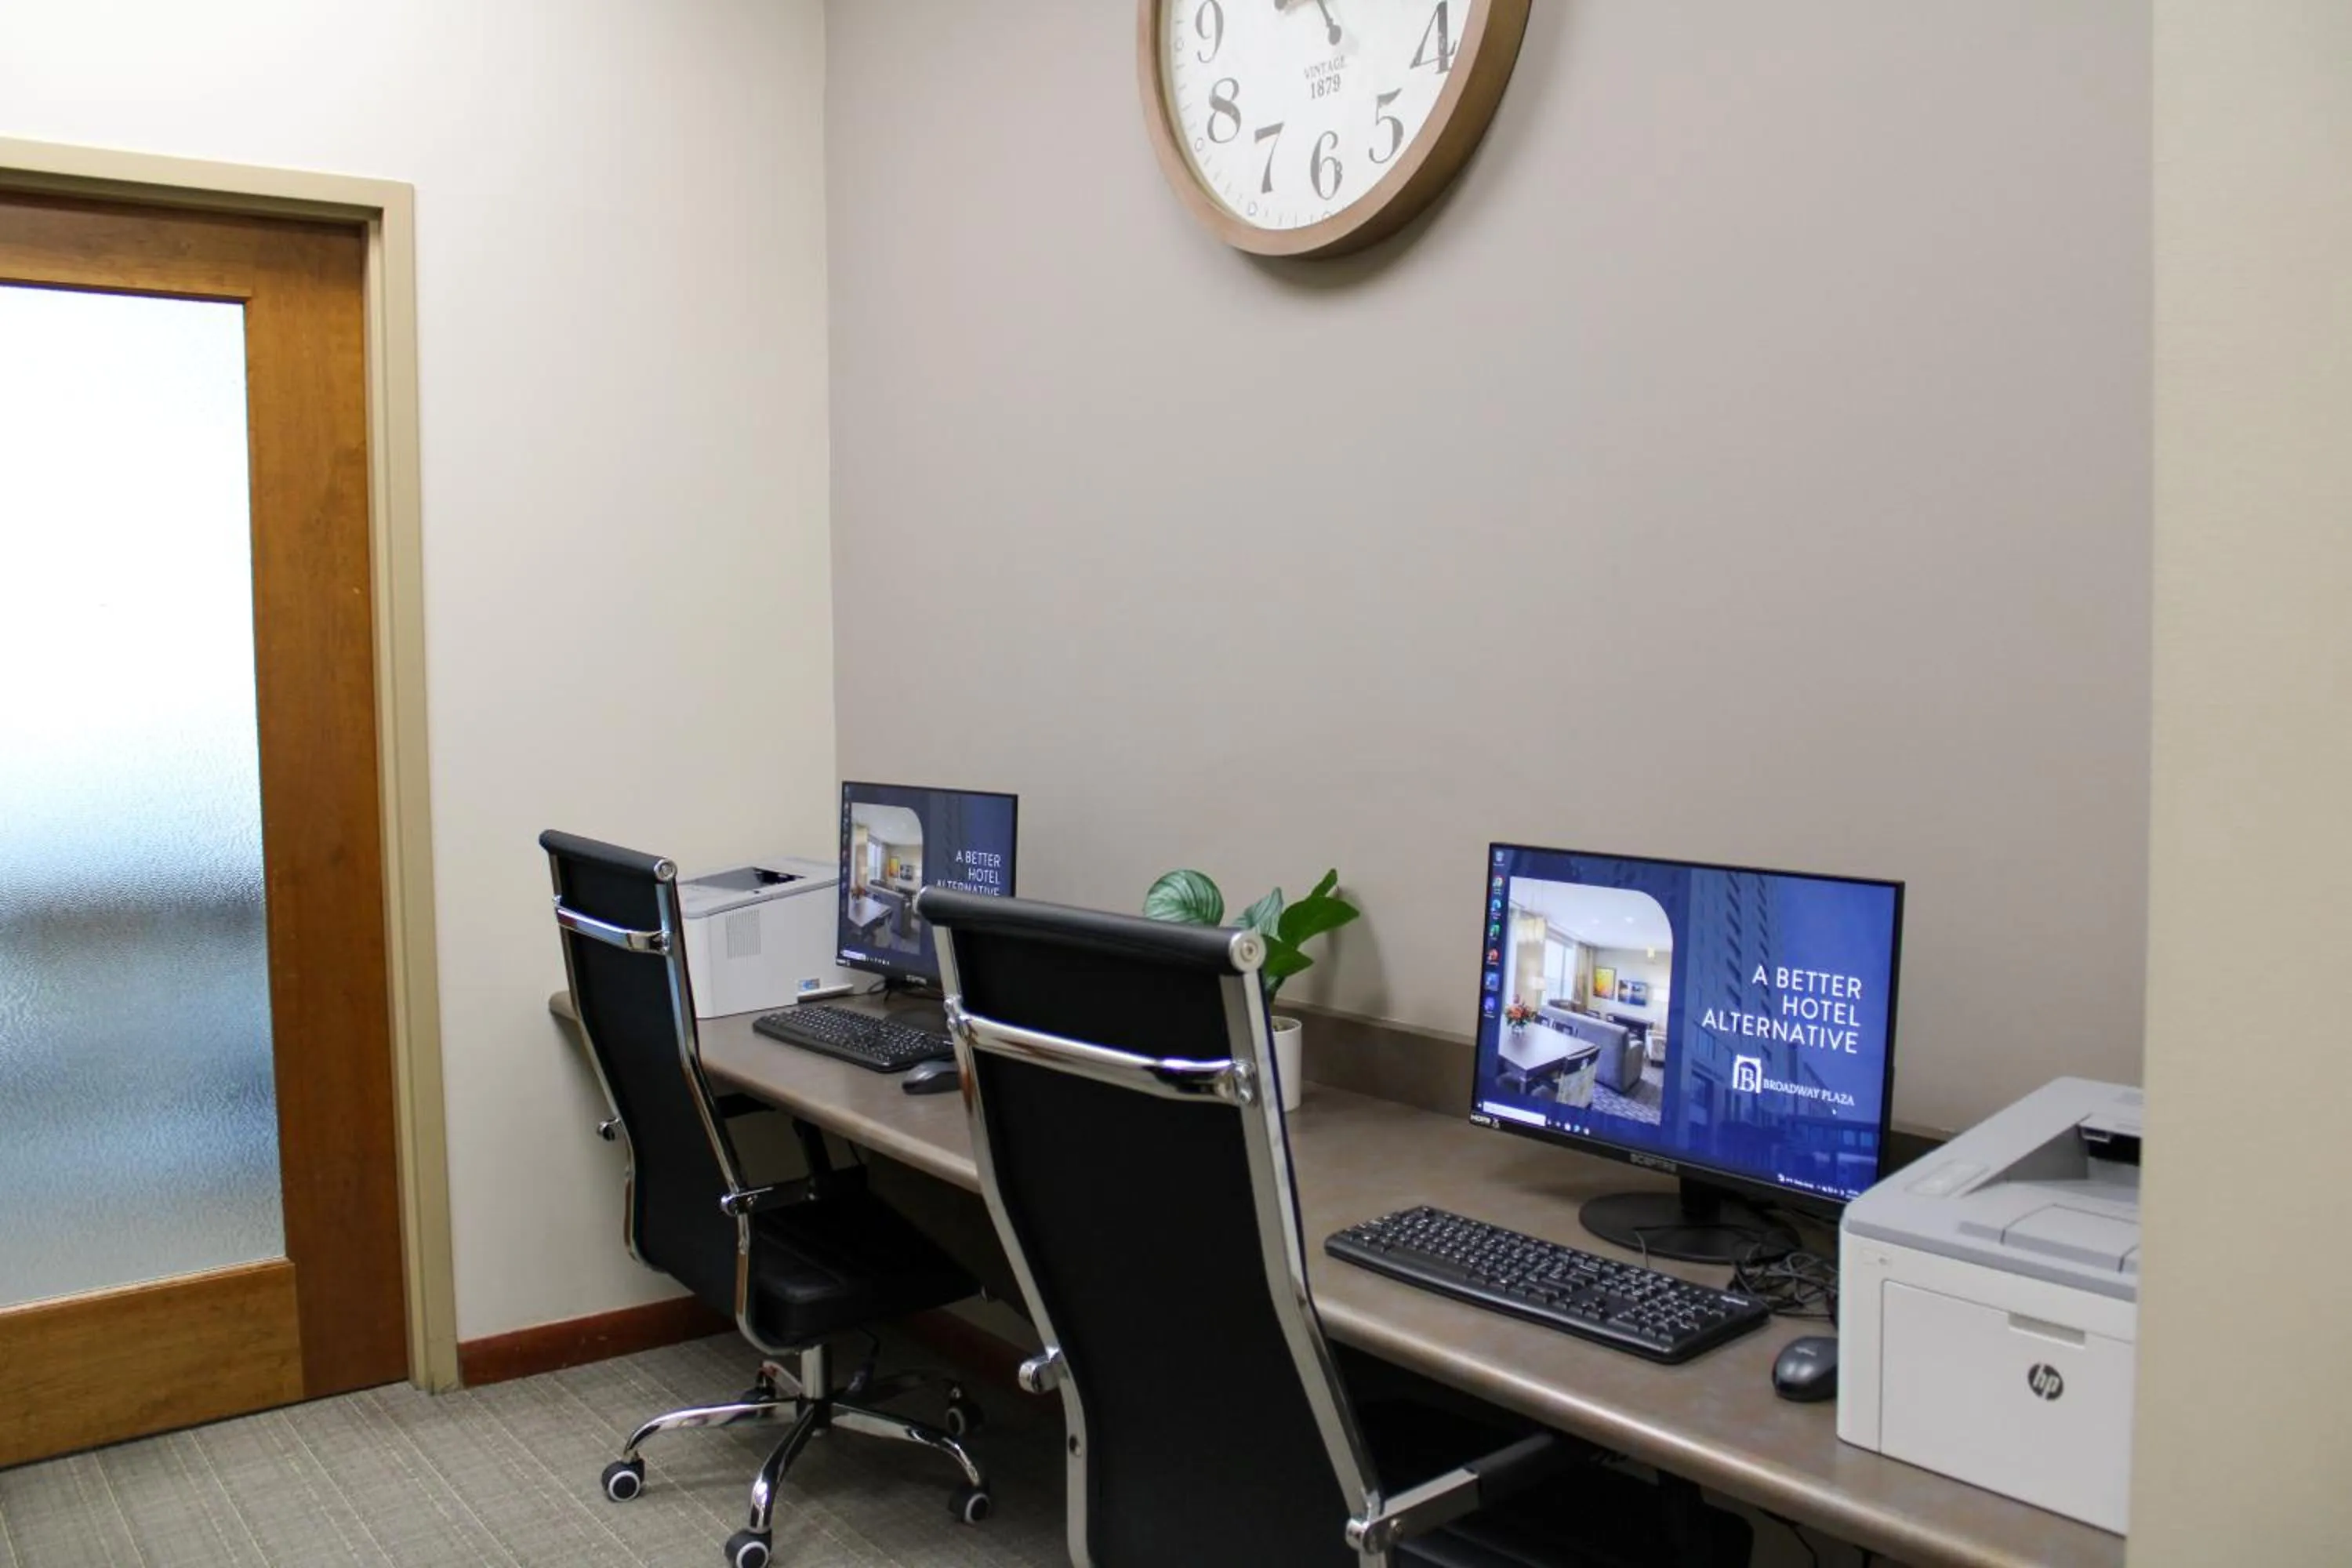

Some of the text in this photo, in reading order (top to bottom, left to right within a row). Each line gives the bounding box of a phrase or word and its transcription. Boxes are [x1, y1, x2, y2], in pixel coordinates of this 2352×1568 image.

[1196, 0, 1224, 64] 9
[1409, 0, 1457, 74] 4
[1303, 54, 1347, 80] VINTAGE
[1311, 73, 1341, 100] 1879
[1207, 77, 1241, 143] 8
[1369, 88, 1404, 164] 5
[1254, 122, 1284, 194] 7
[1310, 130, 1343, 201] 6
[956, 850, 1001, 868] A BETTER
[968, 867, 1001, 885] HOTEL
[1751, 964, 1862, 1000] A BETTER
[1782, 994, 1861, 1027] HOTEL
[1701, 1007, 1858, 1054] ALTERNATIVE
[1763, 1078, 1820, 1098] BROADWAY
[1821, 1088, 1856, 1107] PLAZA
[2031, 1363, 2061, 1400] hp
